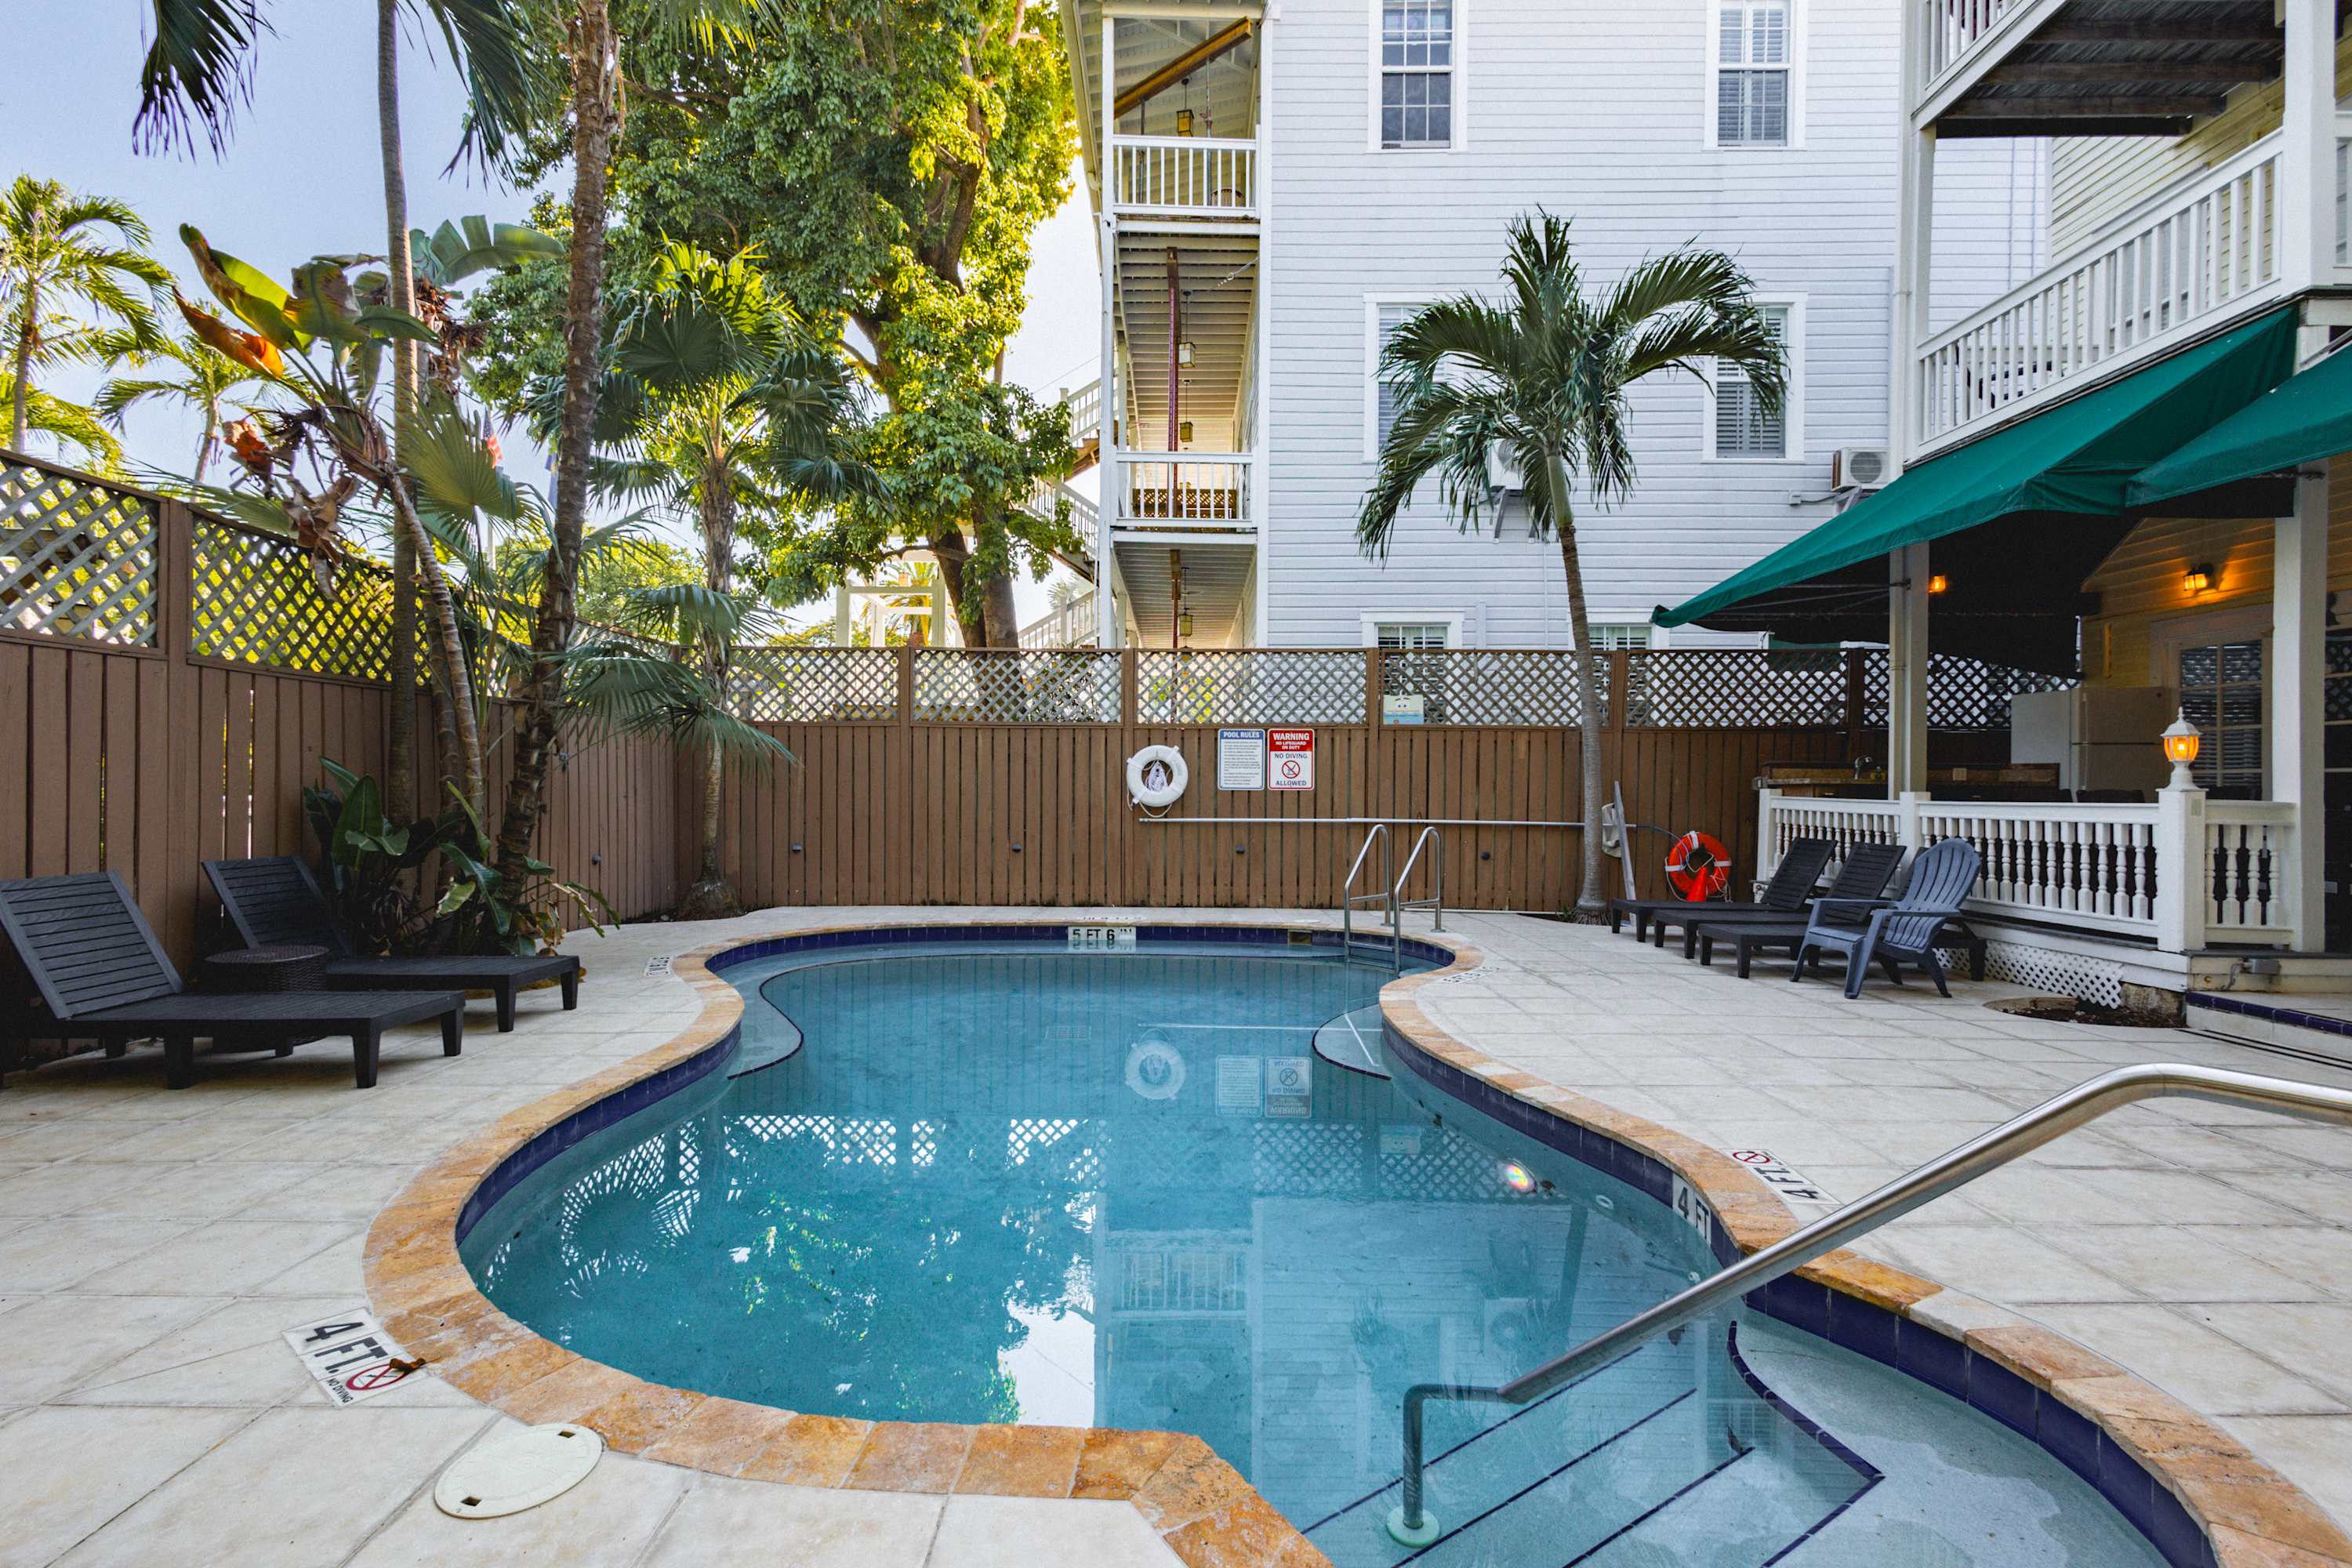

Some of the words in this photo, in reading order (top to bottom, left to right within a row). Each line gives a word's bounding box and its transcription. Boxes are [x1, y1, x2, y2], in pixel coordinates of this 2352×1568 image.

[1272, 732, 1310, 741] WARNING
[1087, 928, 1102, 939] FT
[1106, 928, 1116, 941] 6
[1781, 1189, 1819, 1200] 4
[1678, 1186, 1690, 1220] 4
[1695, 1197, 1710, 1240] FT
[305, 1322, 365, 1343] 4
[326, 1377, 339, 1387] NO
[332, 1385, 354, 1403] DIVING
